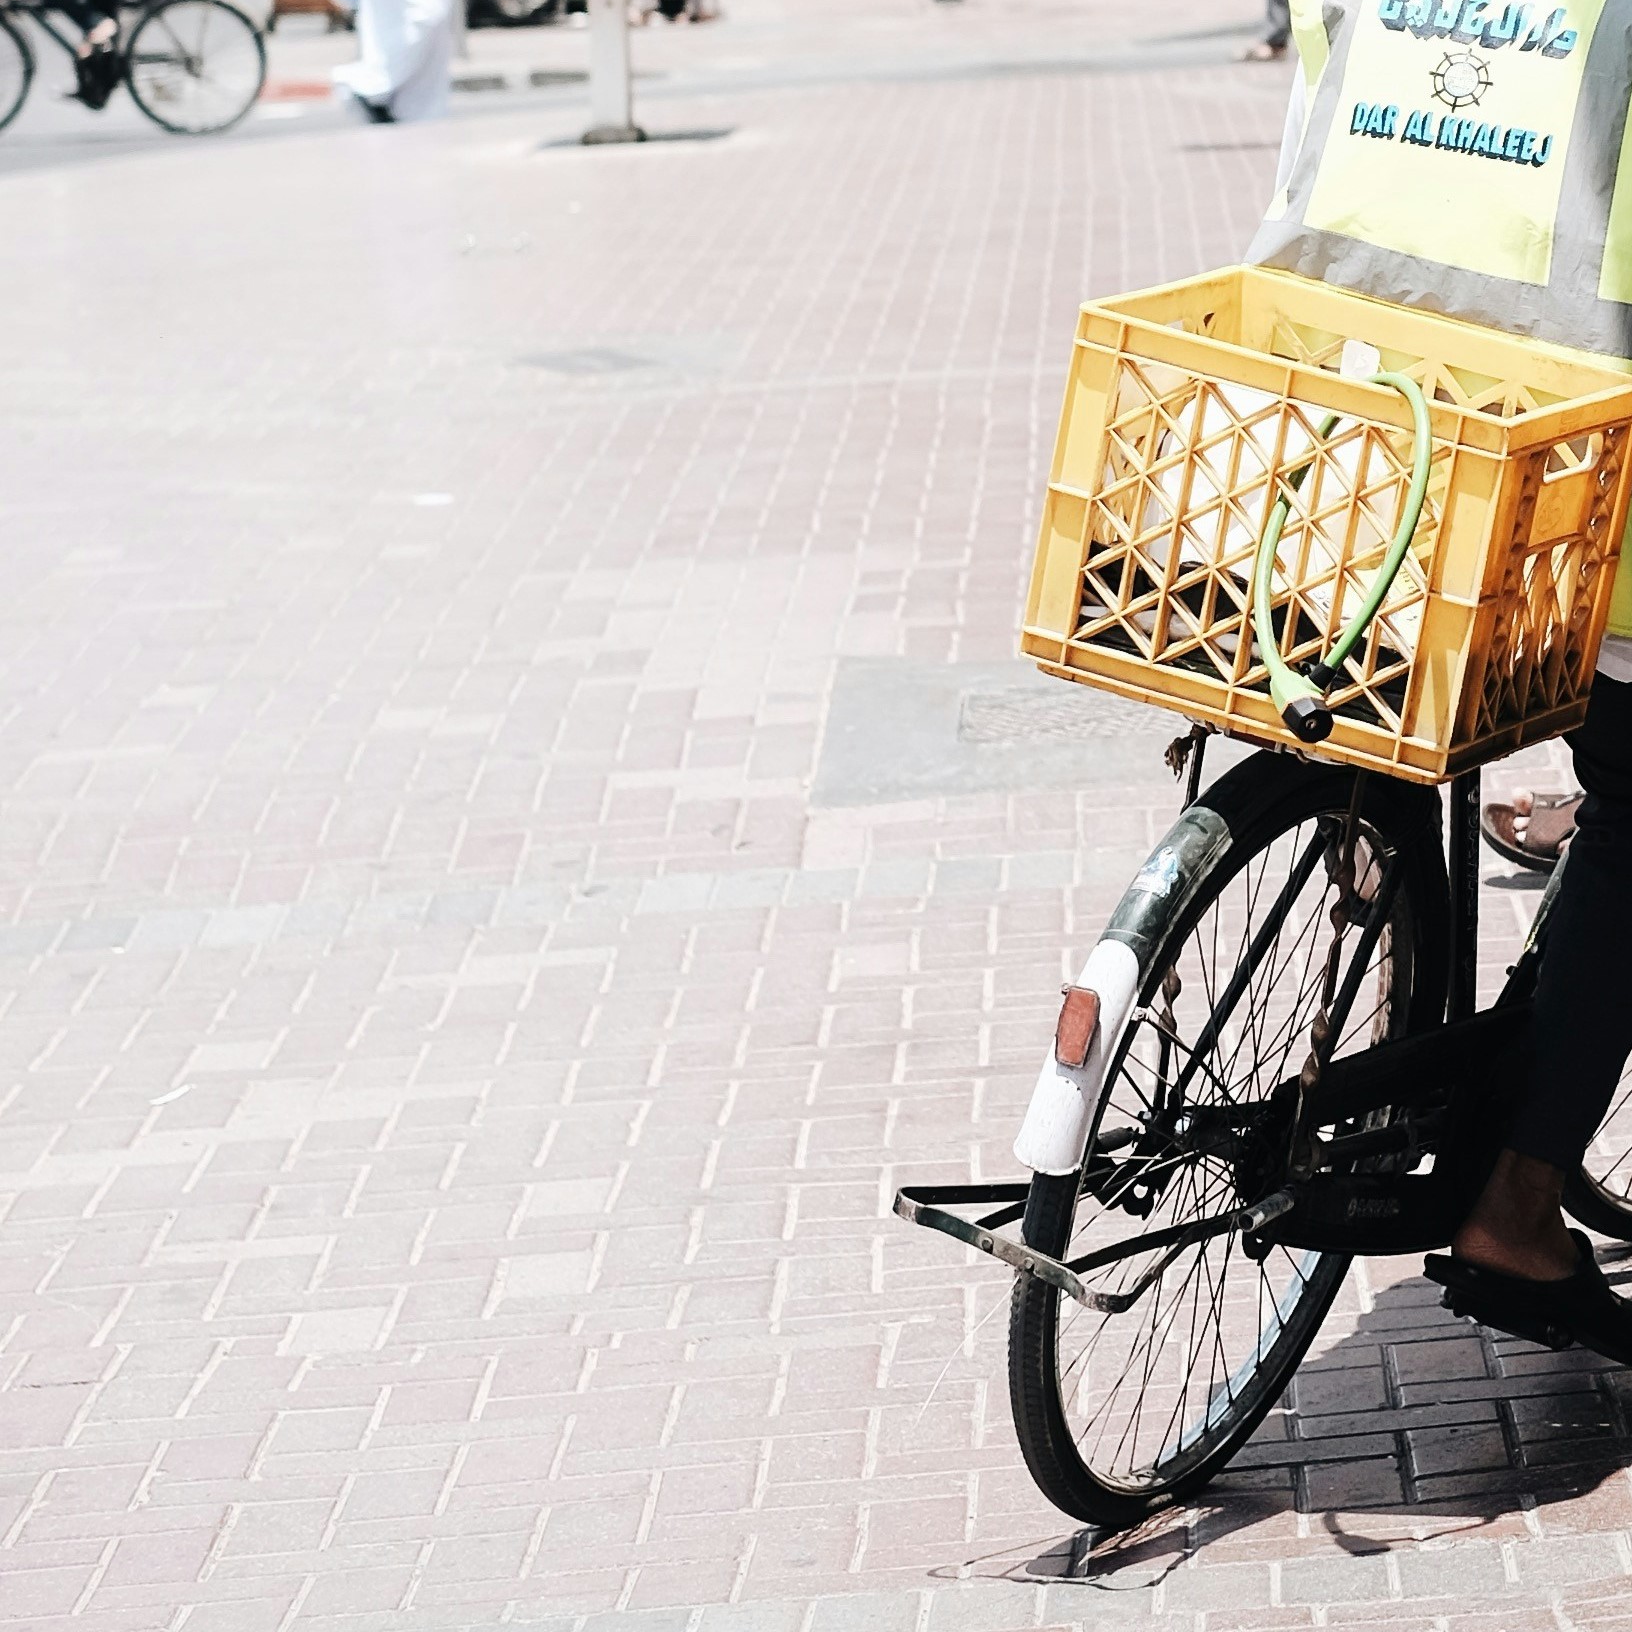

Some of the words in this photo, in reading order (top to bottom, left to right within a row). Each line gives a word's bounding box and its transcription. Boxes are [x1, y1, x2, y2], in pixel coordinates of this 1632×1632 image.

[1350, 102, 1399, 140] DAR
[1400, 109, 1436, 147] AL
[1435, 114, 1554, 168] KHALEEJ
